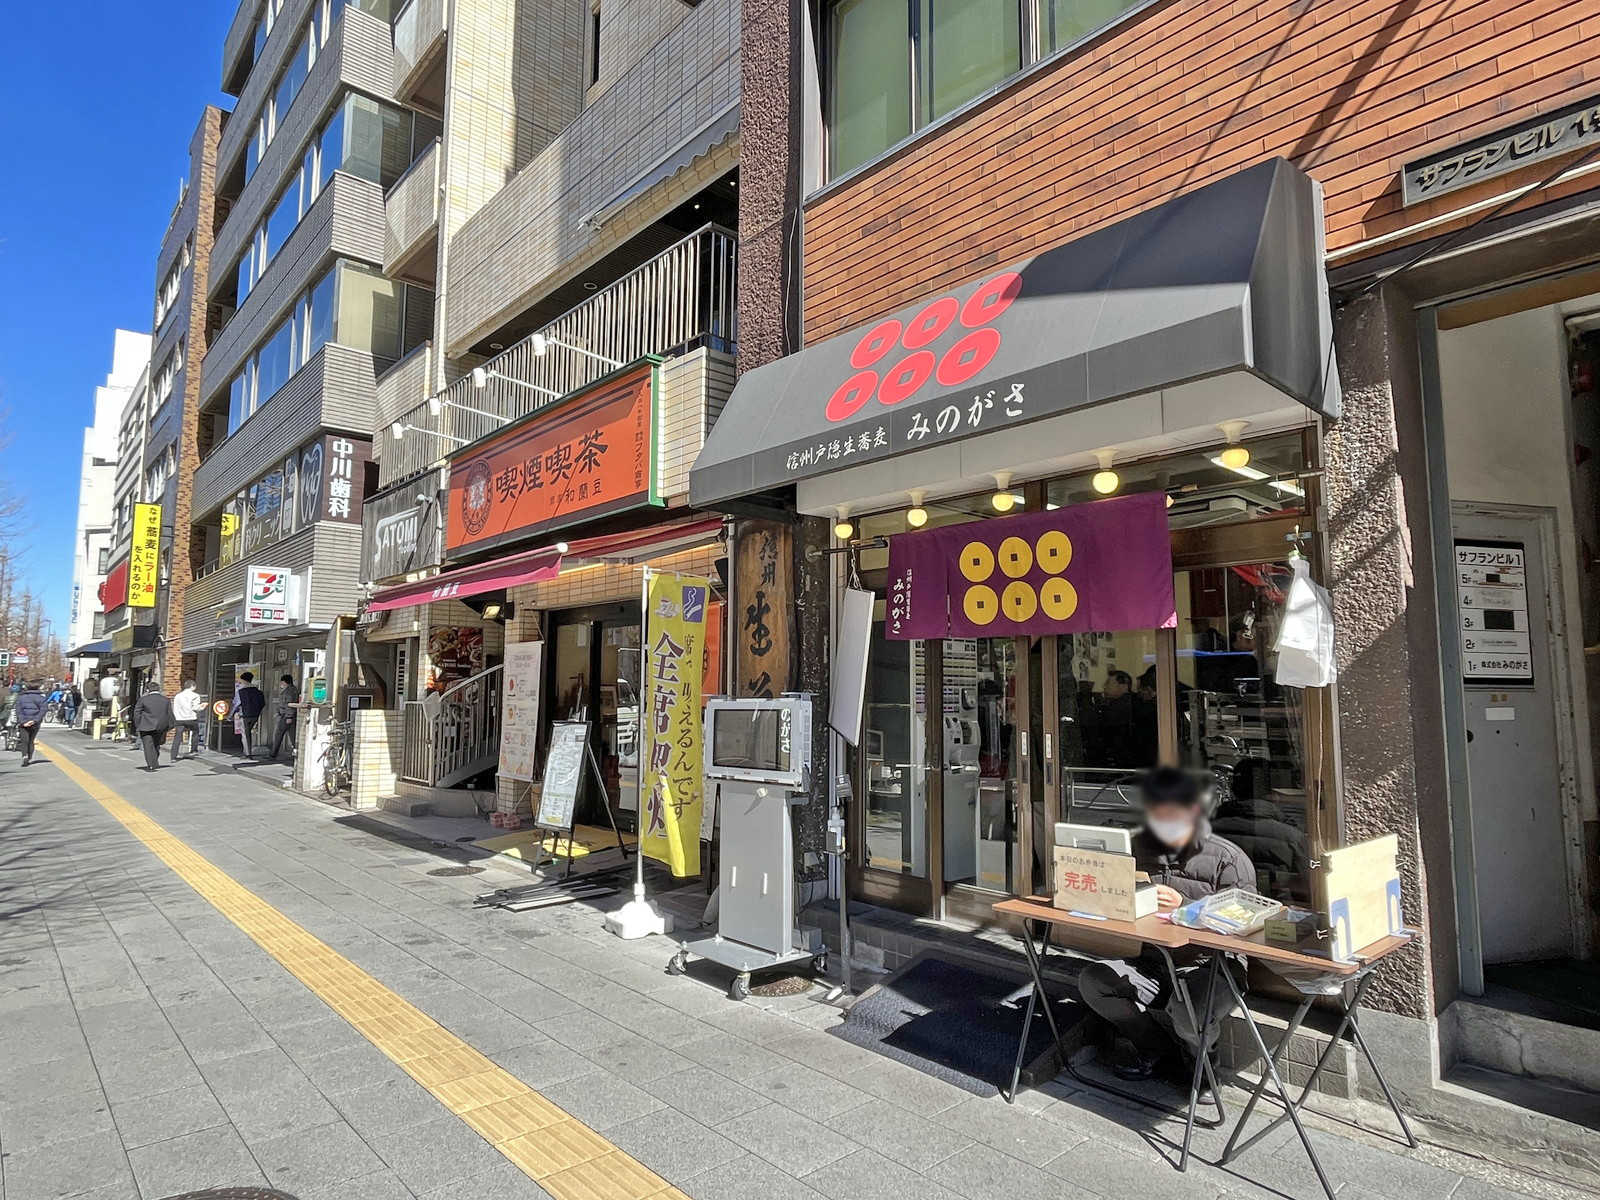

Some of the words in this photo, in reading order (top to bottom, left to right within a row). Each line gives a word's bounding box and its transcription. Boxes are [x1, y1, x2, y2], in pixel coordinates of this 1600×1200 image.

[907, 383, 1025, 440] みのがさ
[496, 429, 608, 504] 喫煙喫茶
[786, 426, 888, 470] 信州戸隠生蕎麦
[328, 438, 353, 519] 中川歯科
[142, 507, 158, 593] なぜ蕎麦にラー油
[374, 505, 421, 563] SATOMI
[1458, 551, 1522, 566] サフランビル1
[892, 578, 905, 634] みのがさ
[1060, 855, 1106, 869] 本日のお弁当は
[1064, 871, 1098, 893] 完売
[1101, 886, 1128, 897] しました
